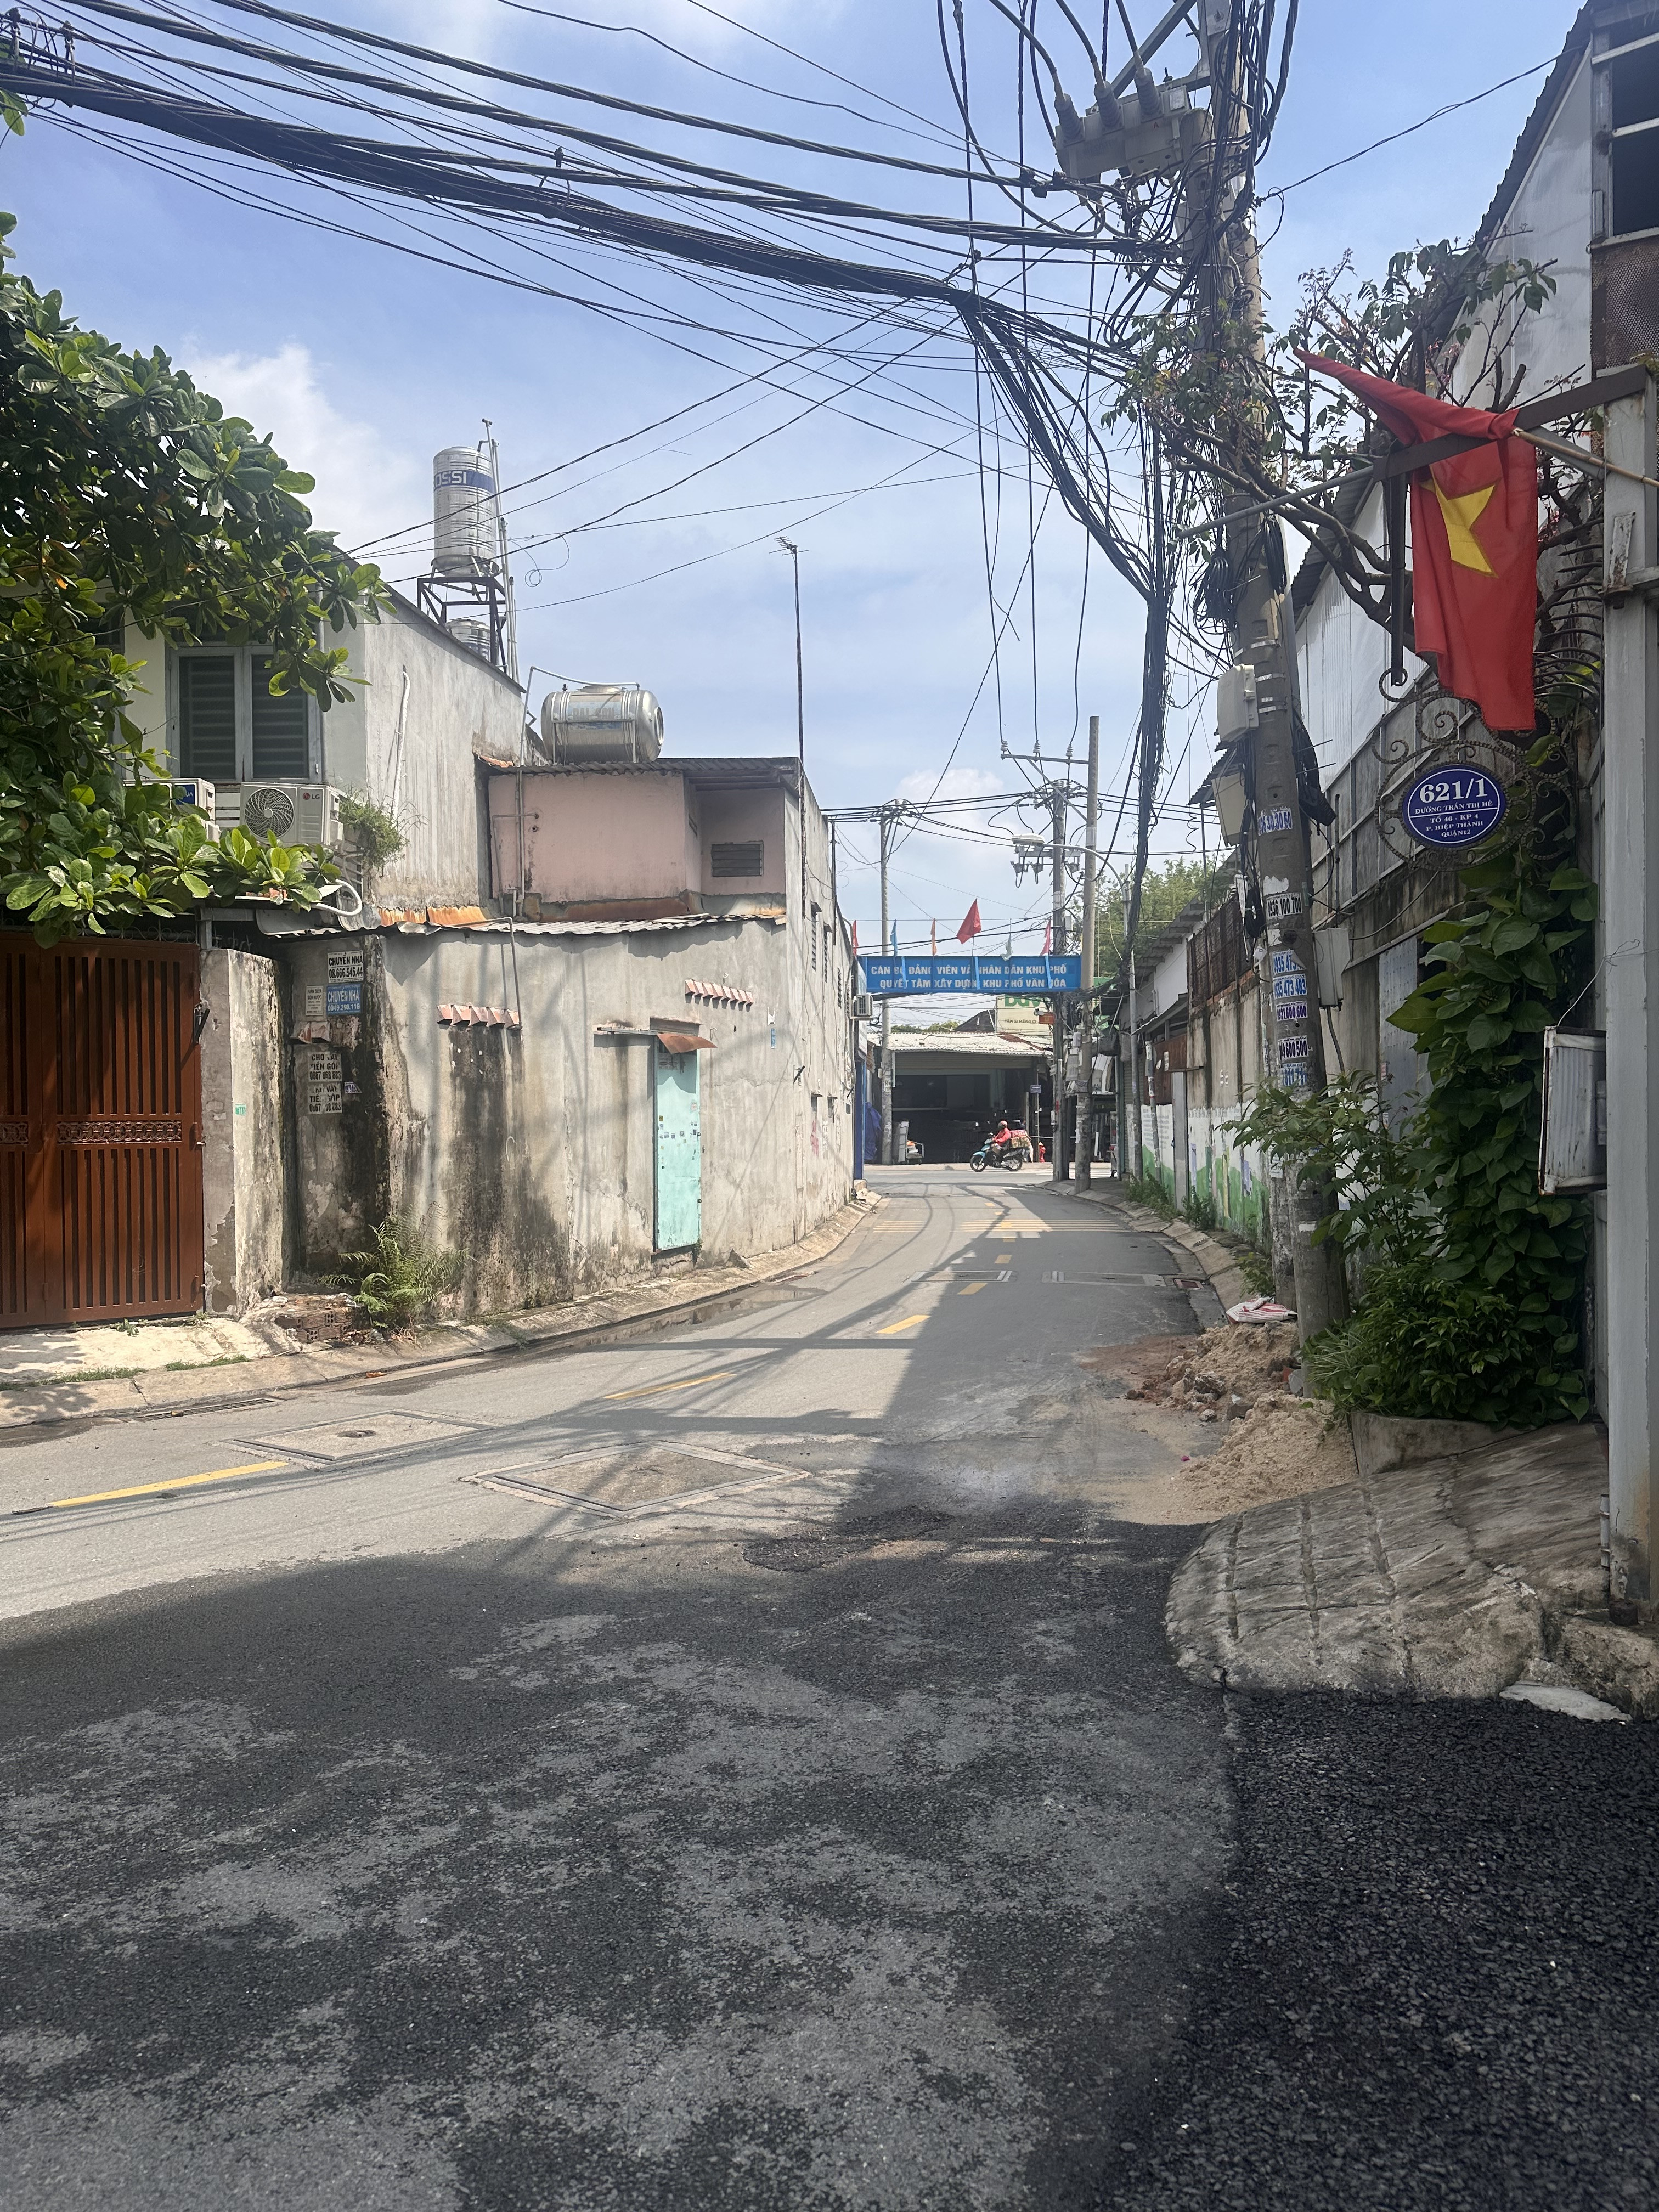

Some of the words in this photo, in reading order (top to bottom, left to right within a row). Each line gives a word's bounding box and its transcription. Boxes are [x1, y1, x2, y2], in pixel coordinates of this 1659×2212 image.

[435, 471, 467, 488] OSSI
[1420, 778, 1488, 803] 621/1
[1415, 805, 1442, 814] ĐƯỜNG
[1435, 822, 1454, 831] HIỆP
[1456, 820, 1483, 828] THÀNH
[352, 954, 363, 964] NHÀ
[871, 965, 890, 974] CÁN
[936, 964, 958, 974] VIÊN
[1004, 964, 1024, 974] DÂN
[911, 978, 931, 988] TÂM
[934, 978, 952, 988] XÂY
[1026, 978, 1045, 988] VĂN
